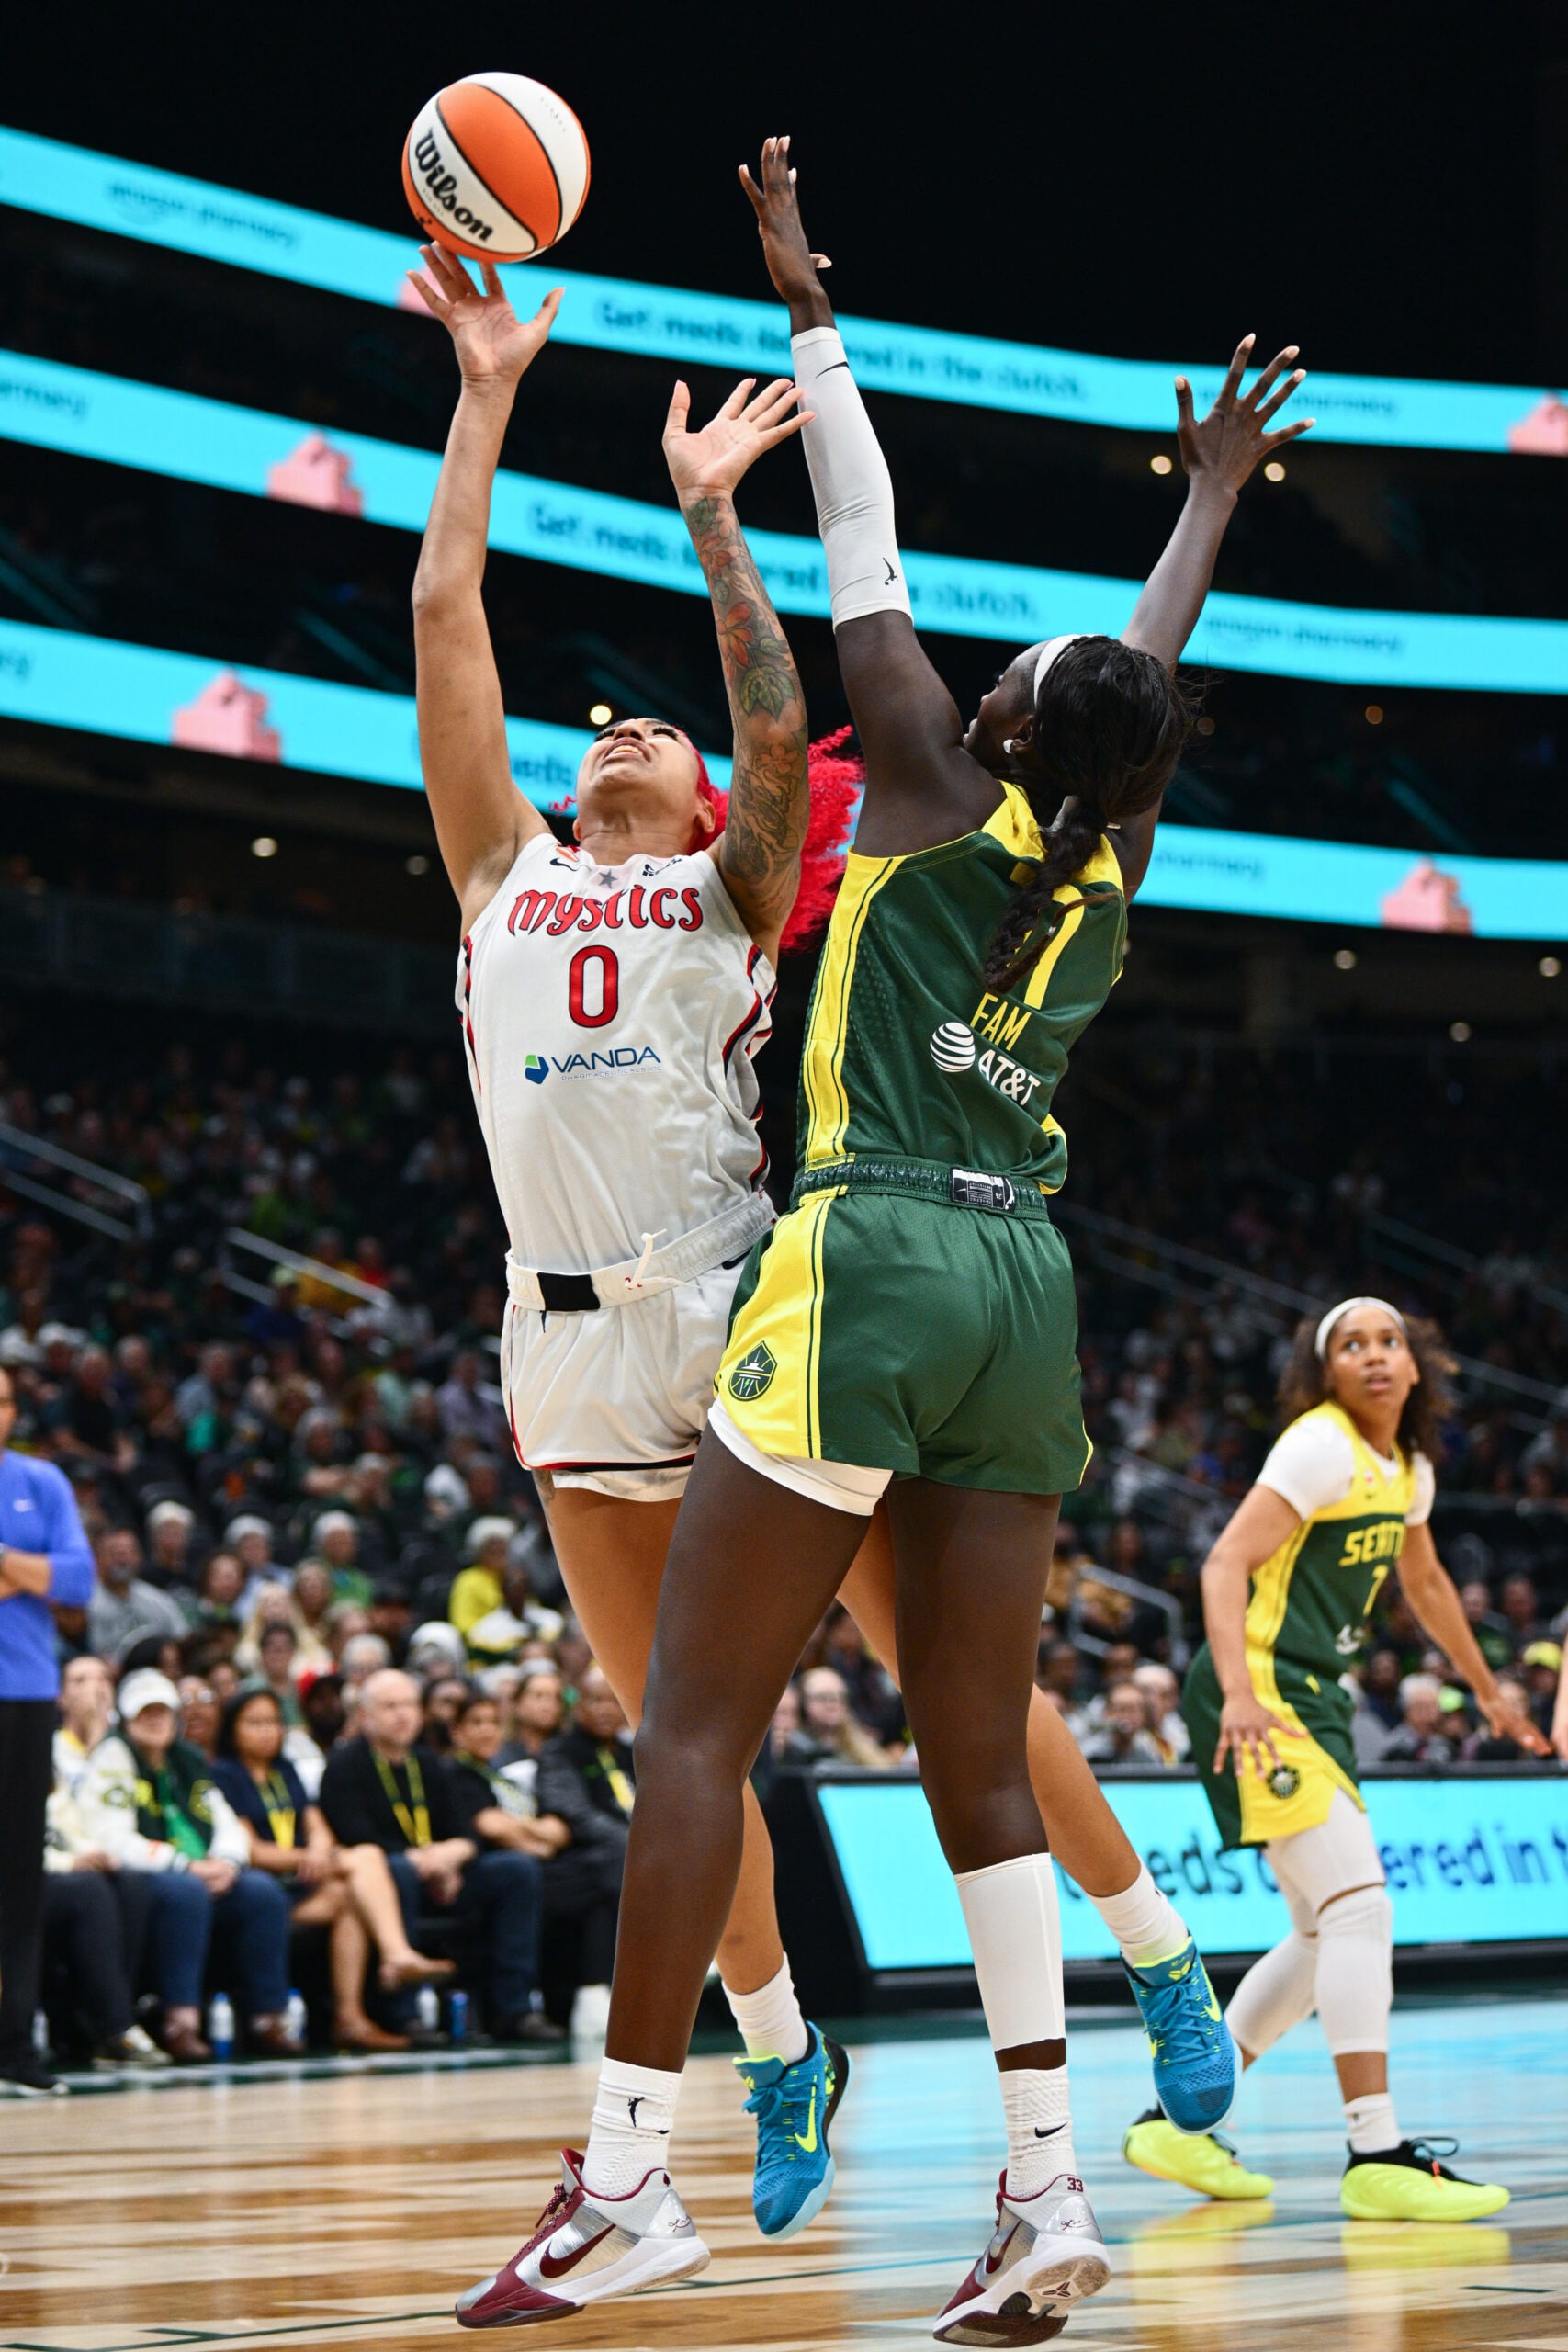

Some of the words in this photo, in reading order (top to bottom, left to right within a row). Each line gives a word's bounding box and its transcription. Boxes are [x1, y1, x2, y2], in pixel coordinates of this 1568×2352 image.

[415, 127, 493, 243] Wilson
[569, 944, 618, 1028] 0
[969, 992, 1032, 1051] FAM
[551, 1046, 661, 1073] VANDA
[978, 1049, 1041, 1106] AT&T
[1067, 2177, 1083, 2192] 33
